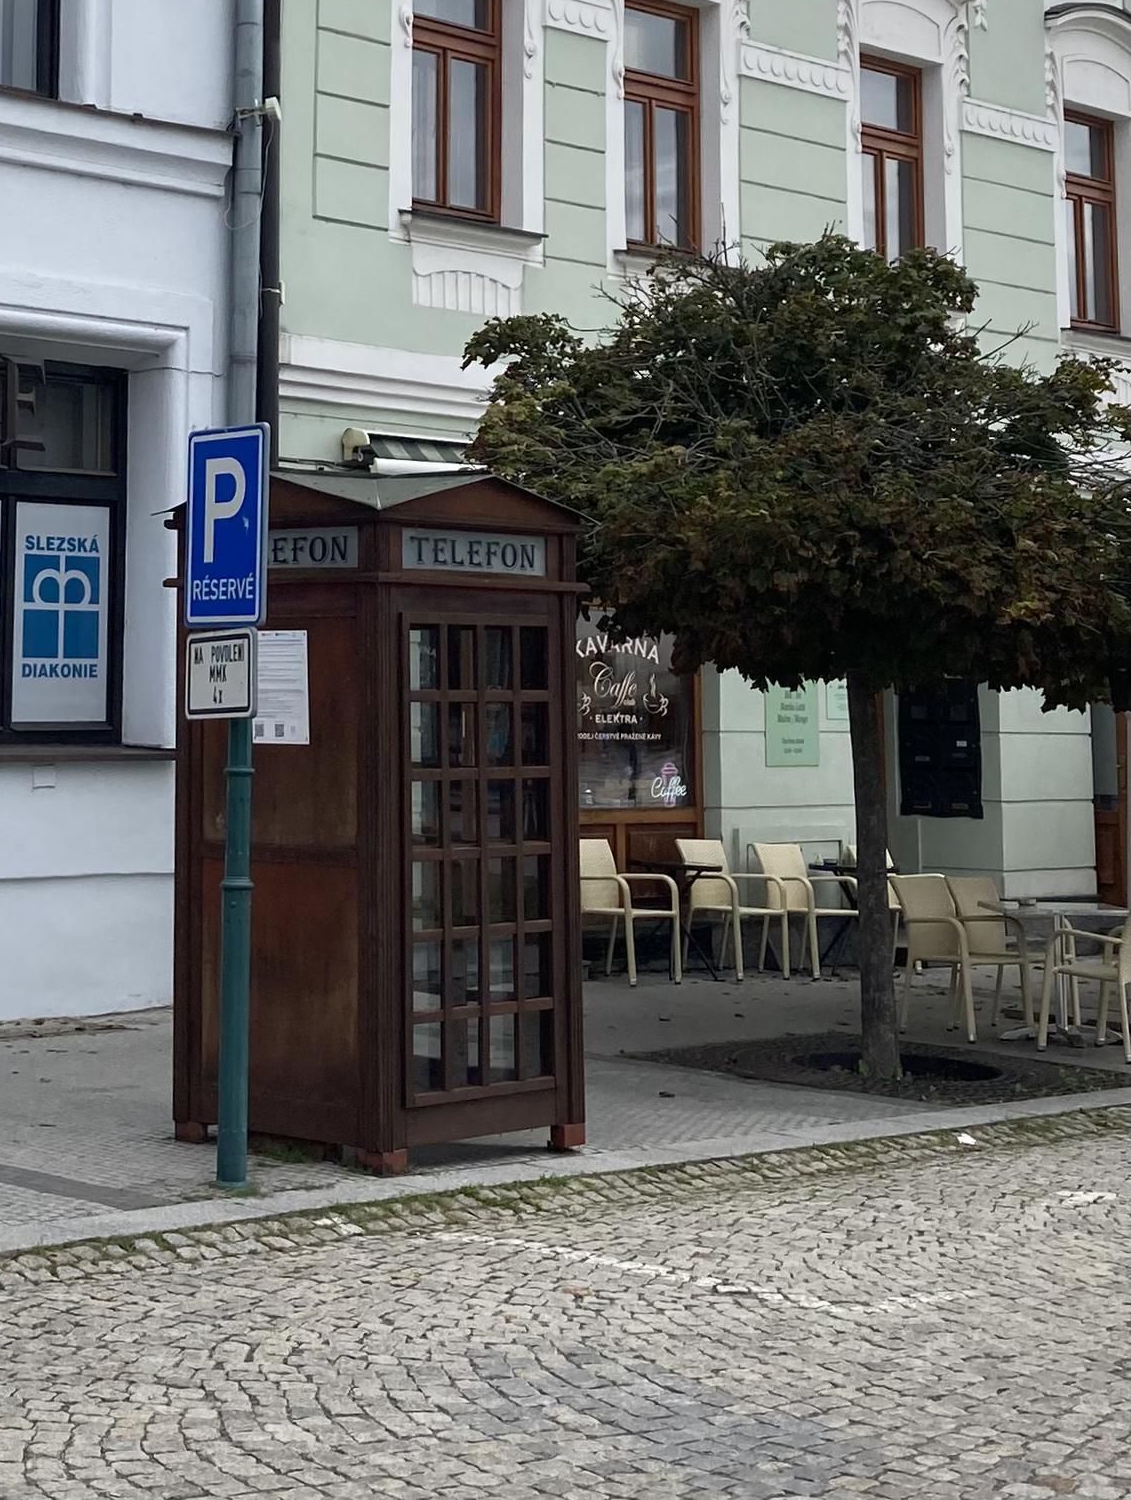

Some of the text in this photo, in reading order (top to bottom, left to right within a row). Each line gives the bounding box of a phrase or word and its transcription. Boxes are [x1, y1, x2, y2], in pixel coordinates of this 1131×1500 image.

[203, 457, 246, 564] P
[25, 534, 100, 553] SLEZSKÁ
[268, 535, 348, 563] EFON
[409, 536, 535, 570] TELEFON
[193, 573, 254, 601] RÉSERVÉ
[194, 646, 204, 665] NA
[22, 663, 98, 678] DIAKONIE
[589, 661, 637, 709] Caffe
[595, 713, 638, 724] ELEKTRA
